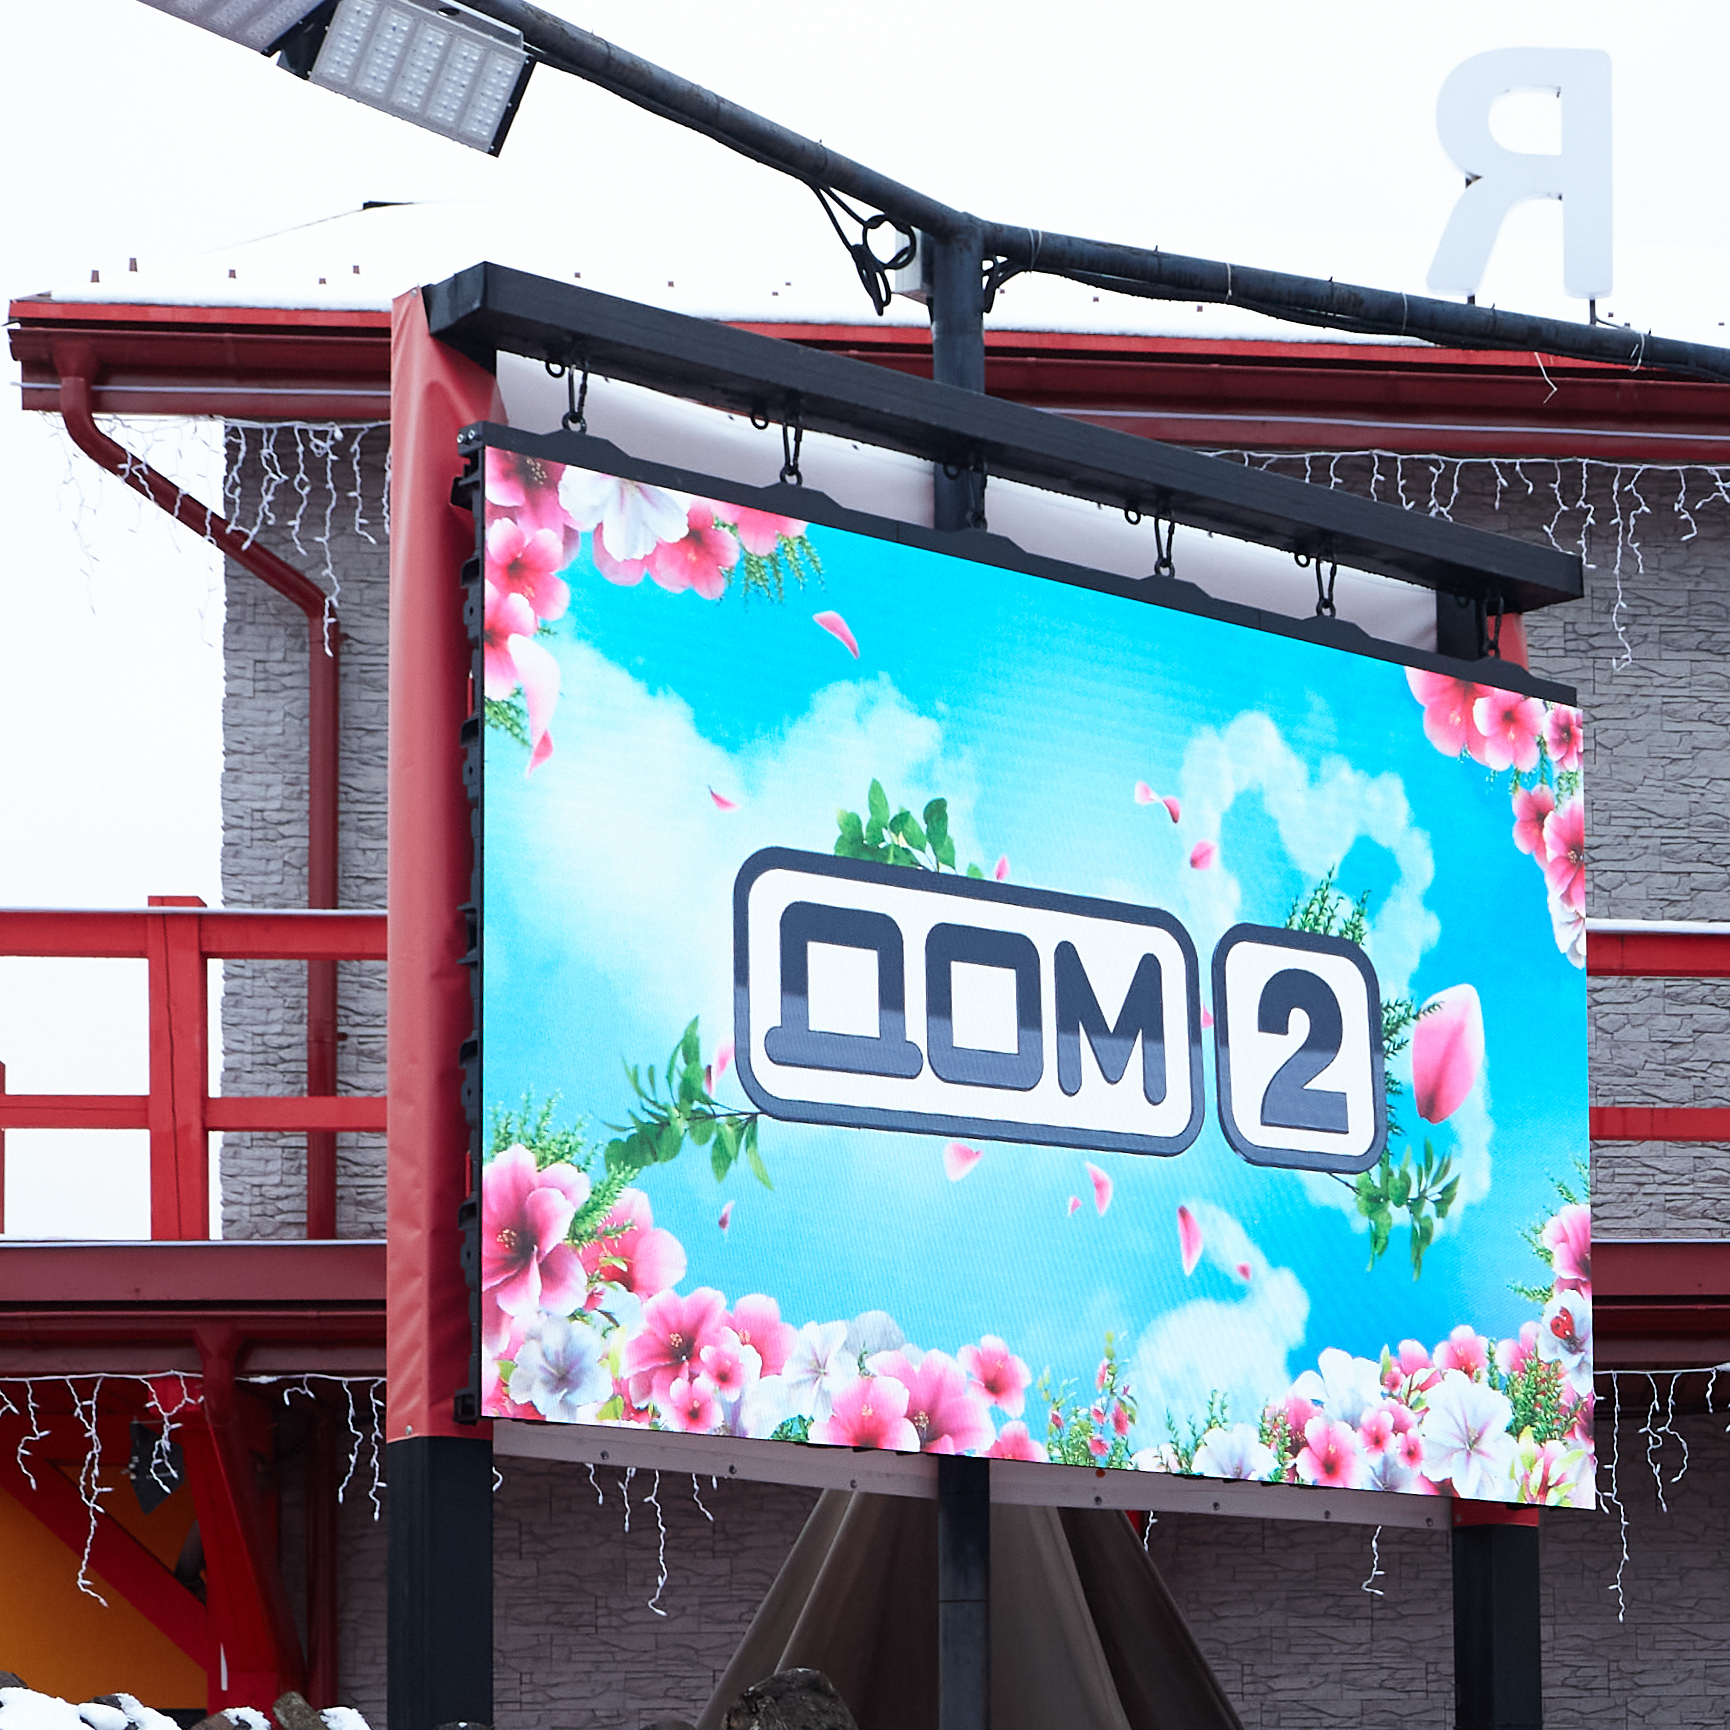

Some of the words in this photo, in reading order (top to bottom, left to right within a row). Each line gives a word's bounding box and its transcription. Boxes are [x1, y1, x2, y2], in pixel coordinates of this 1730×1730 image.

[1426, 46, 1613, 299] Я
[764, 901, 1167, 1106] ДОМ
[1258, 968, 1350, 1135] 2
